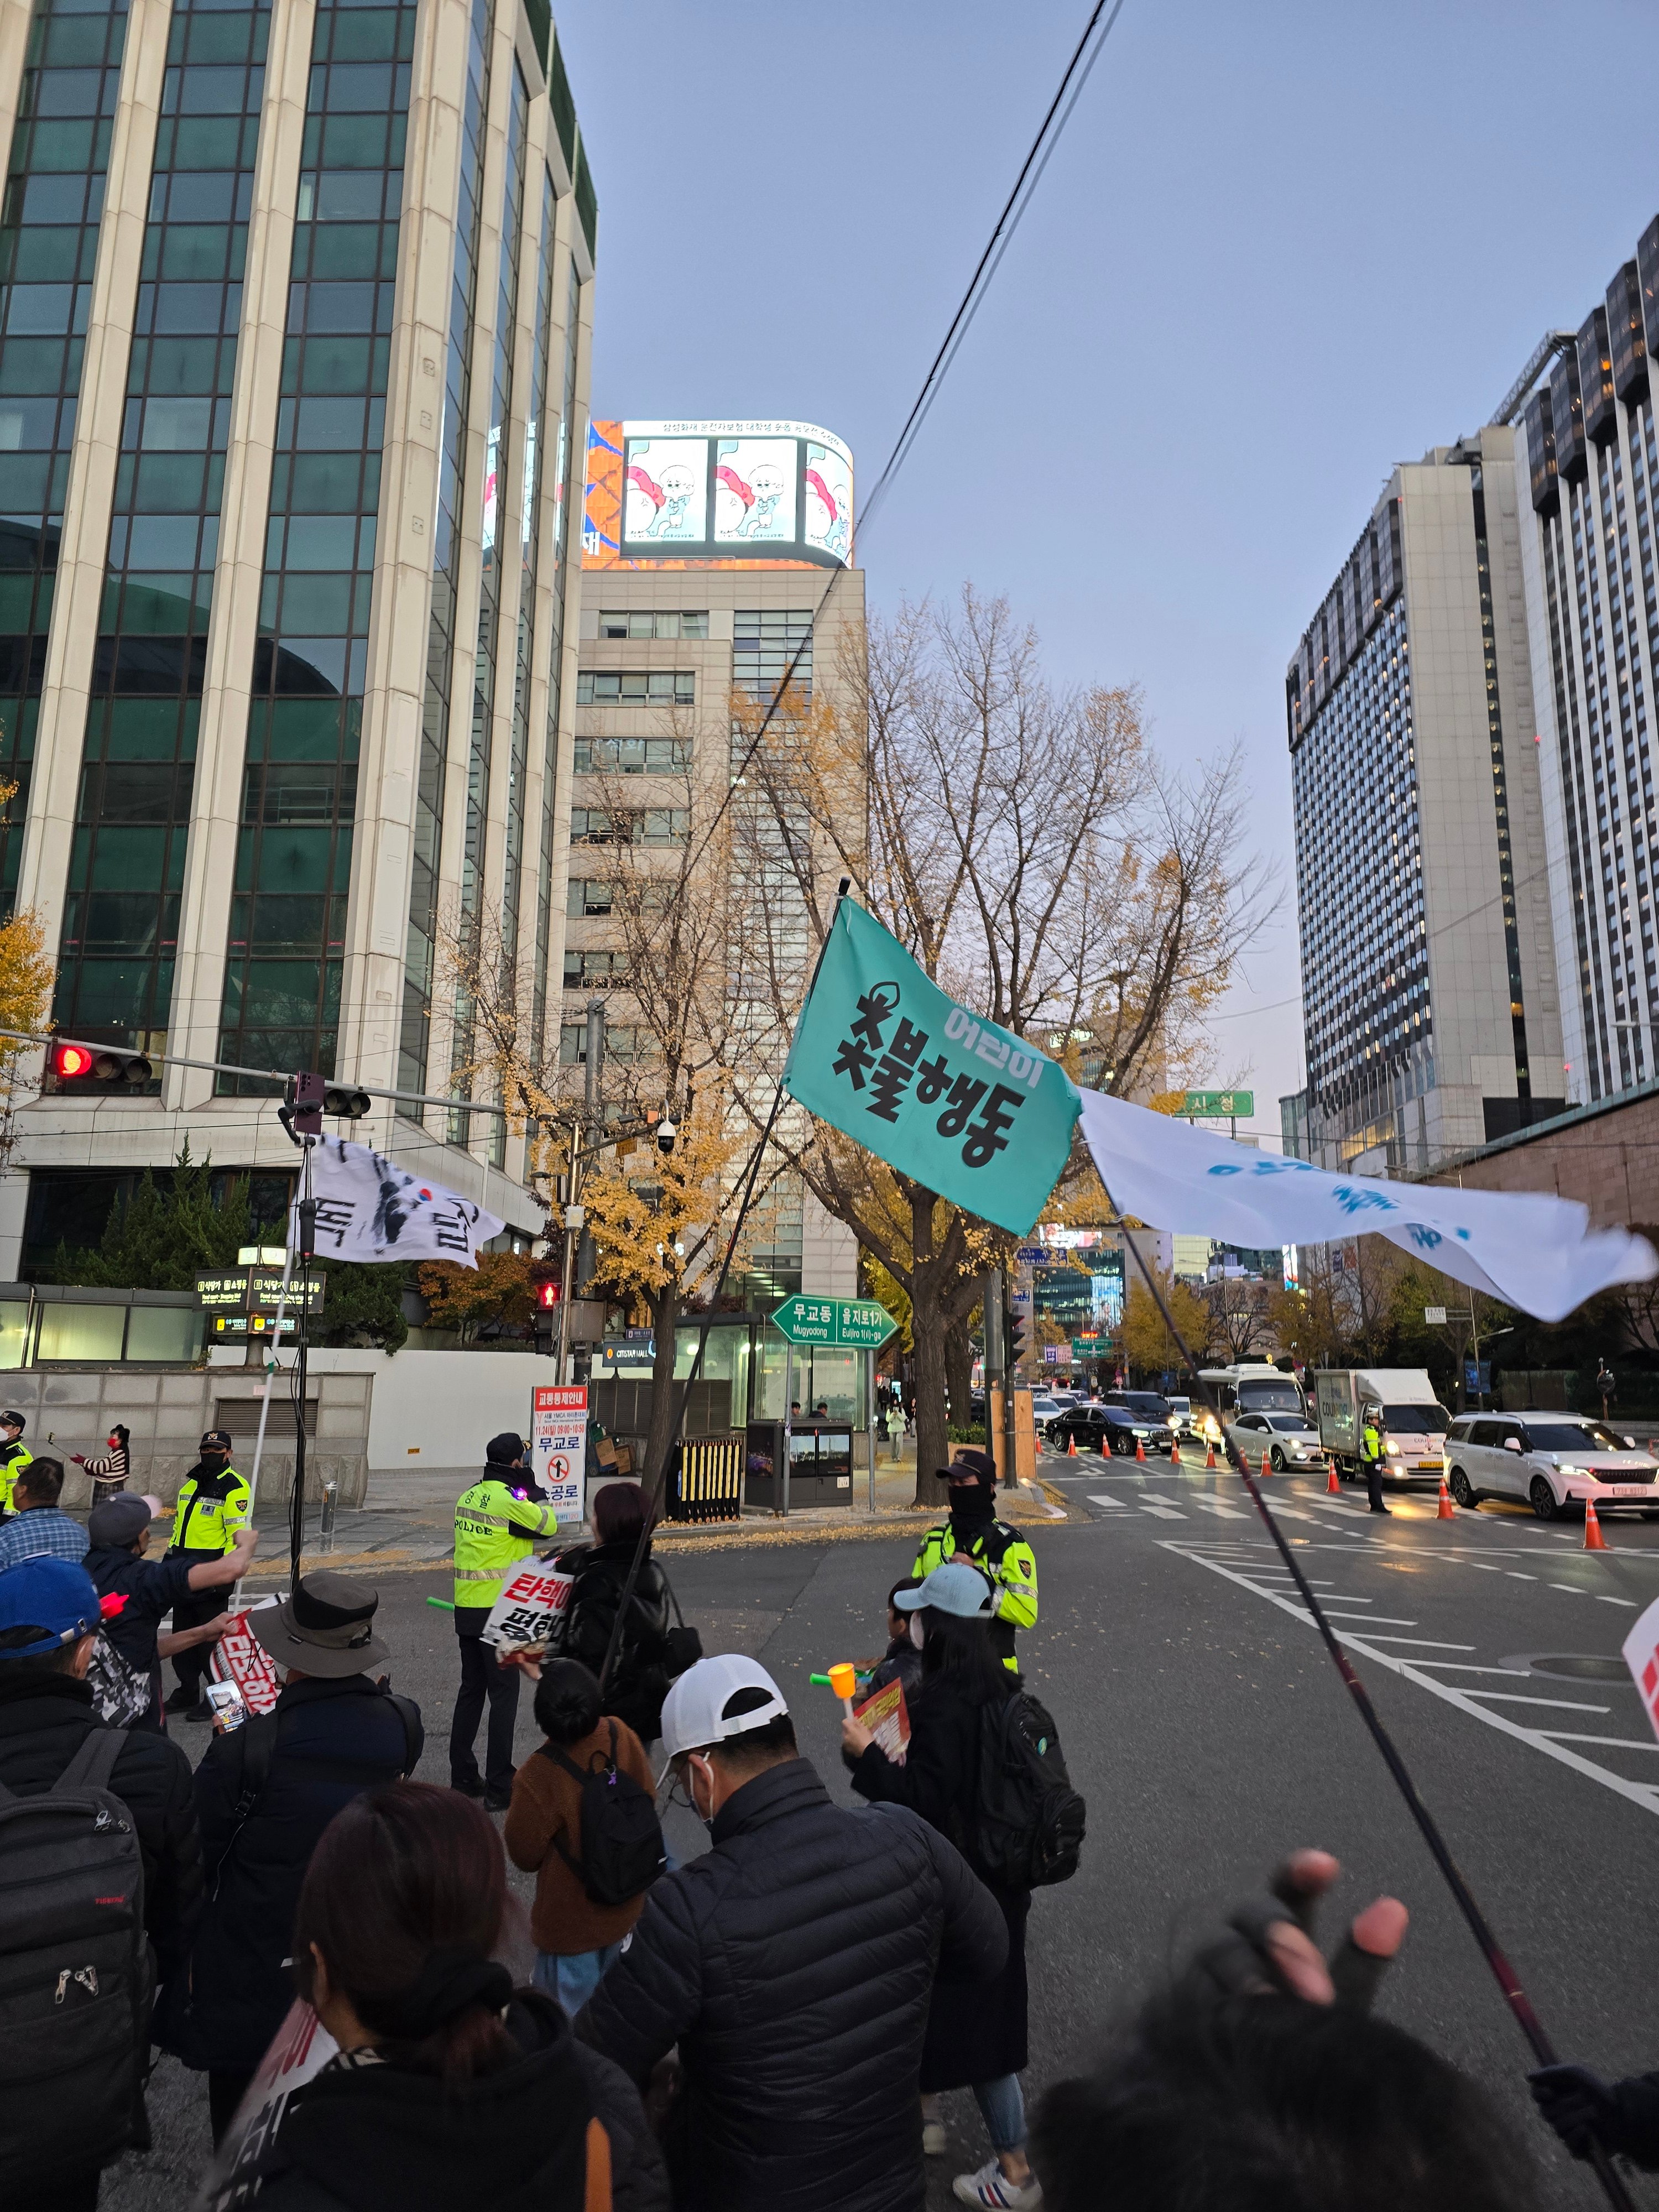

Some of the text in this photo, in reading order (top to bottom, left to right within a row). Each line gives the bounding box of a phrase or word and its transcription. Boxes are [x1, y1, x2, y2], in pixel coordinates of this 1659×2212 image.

[663, 423, 697, 431] 삼성화재
[747, 423, 771, 431] 대학생
[944, 1007, 1045, 1089] 어린이
[832, 982, 1027, 1168] 촛불행동
[794, 1303, 882, 1327] 무교동 을지로1가
[793, 1324, 827, 1339] Mugyodong
[842, 1328, 860, 1340] Euljiro
[539, 1391, 583, 1406] 교통통제안내
[536, 1425, 556, 1436] 11.24(일)
[539, 1437, 580, 1452] 무교로
[465, 1491, 491, 1509] 경찰
[455, 1519, 492, 1536] POLICE
